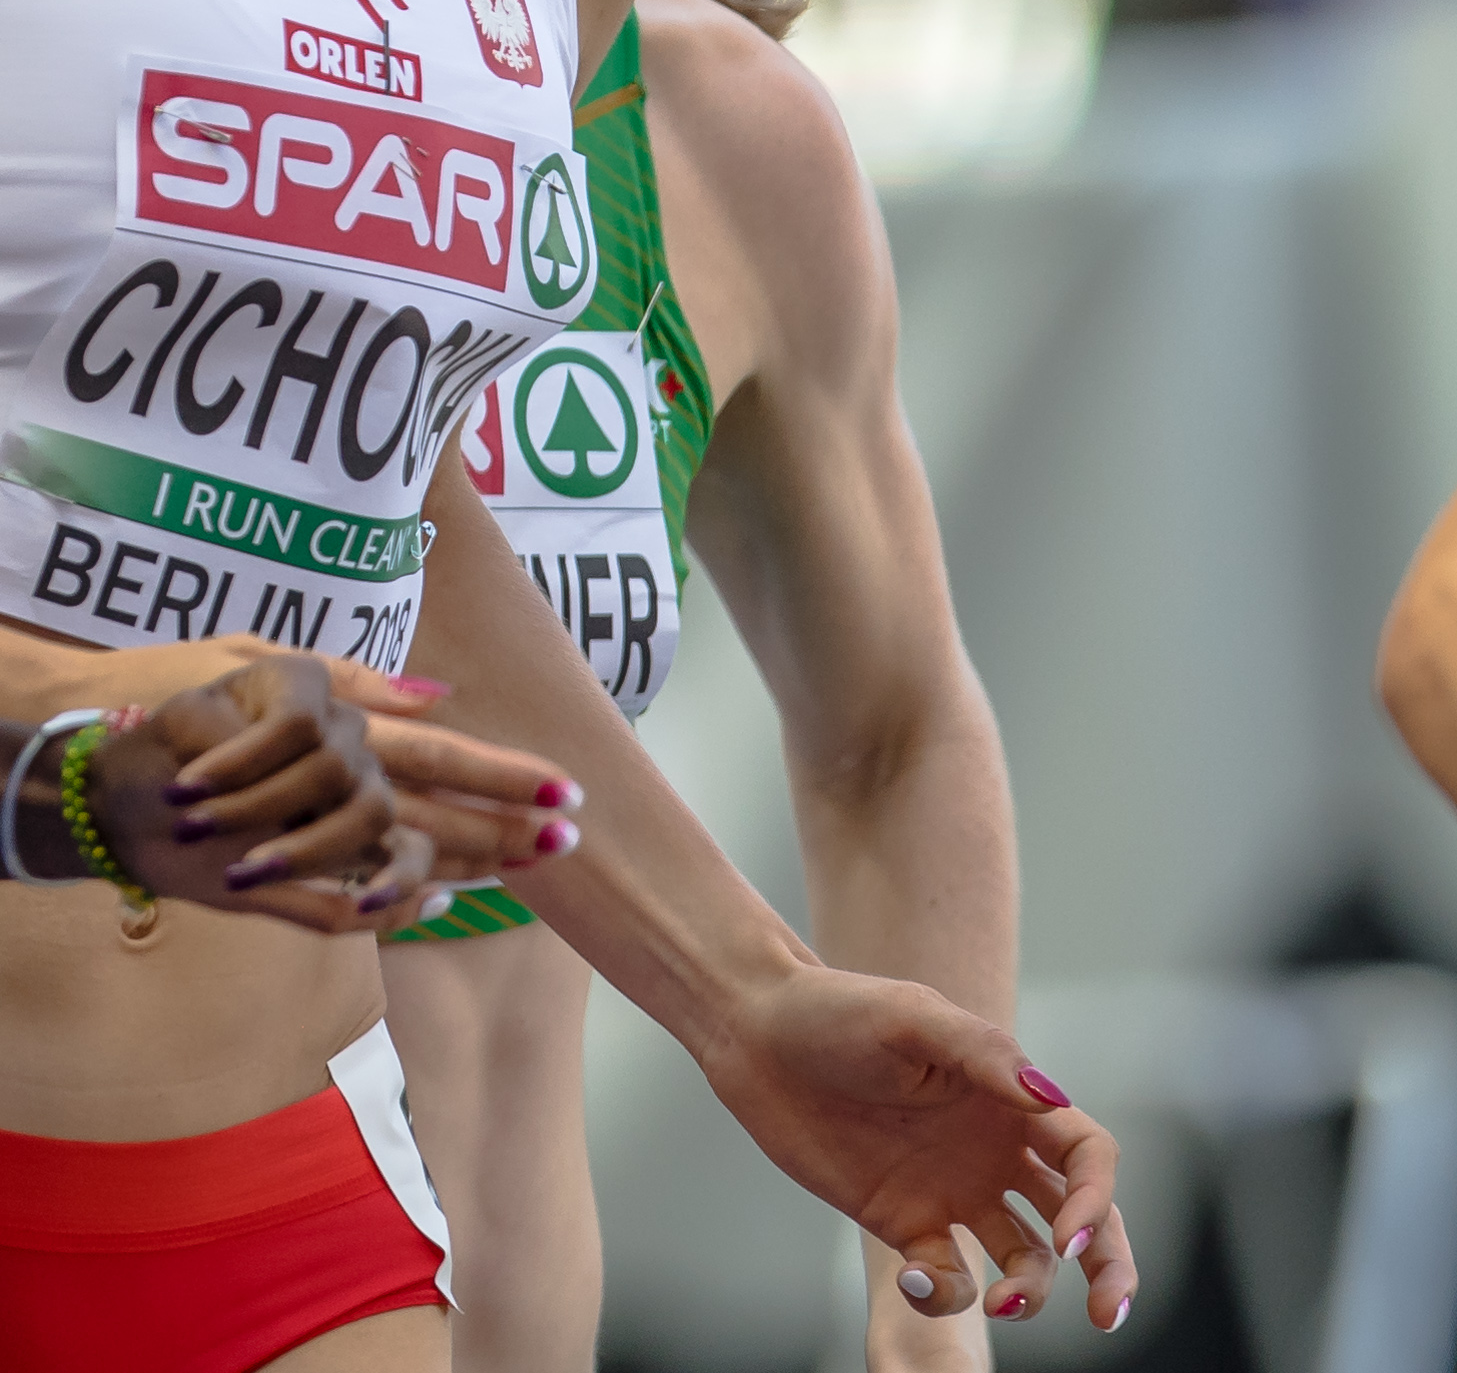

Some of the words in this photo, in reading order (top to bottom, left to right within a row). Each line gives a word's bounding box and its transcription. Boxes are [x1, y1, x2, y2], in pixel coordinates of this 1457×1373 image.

[290, 37, 418, 97] ORLEN
[150, 95, 505, 266] SPAR
[152, 472, 174, 520] I
[182, 481, 302, 555] RUN
